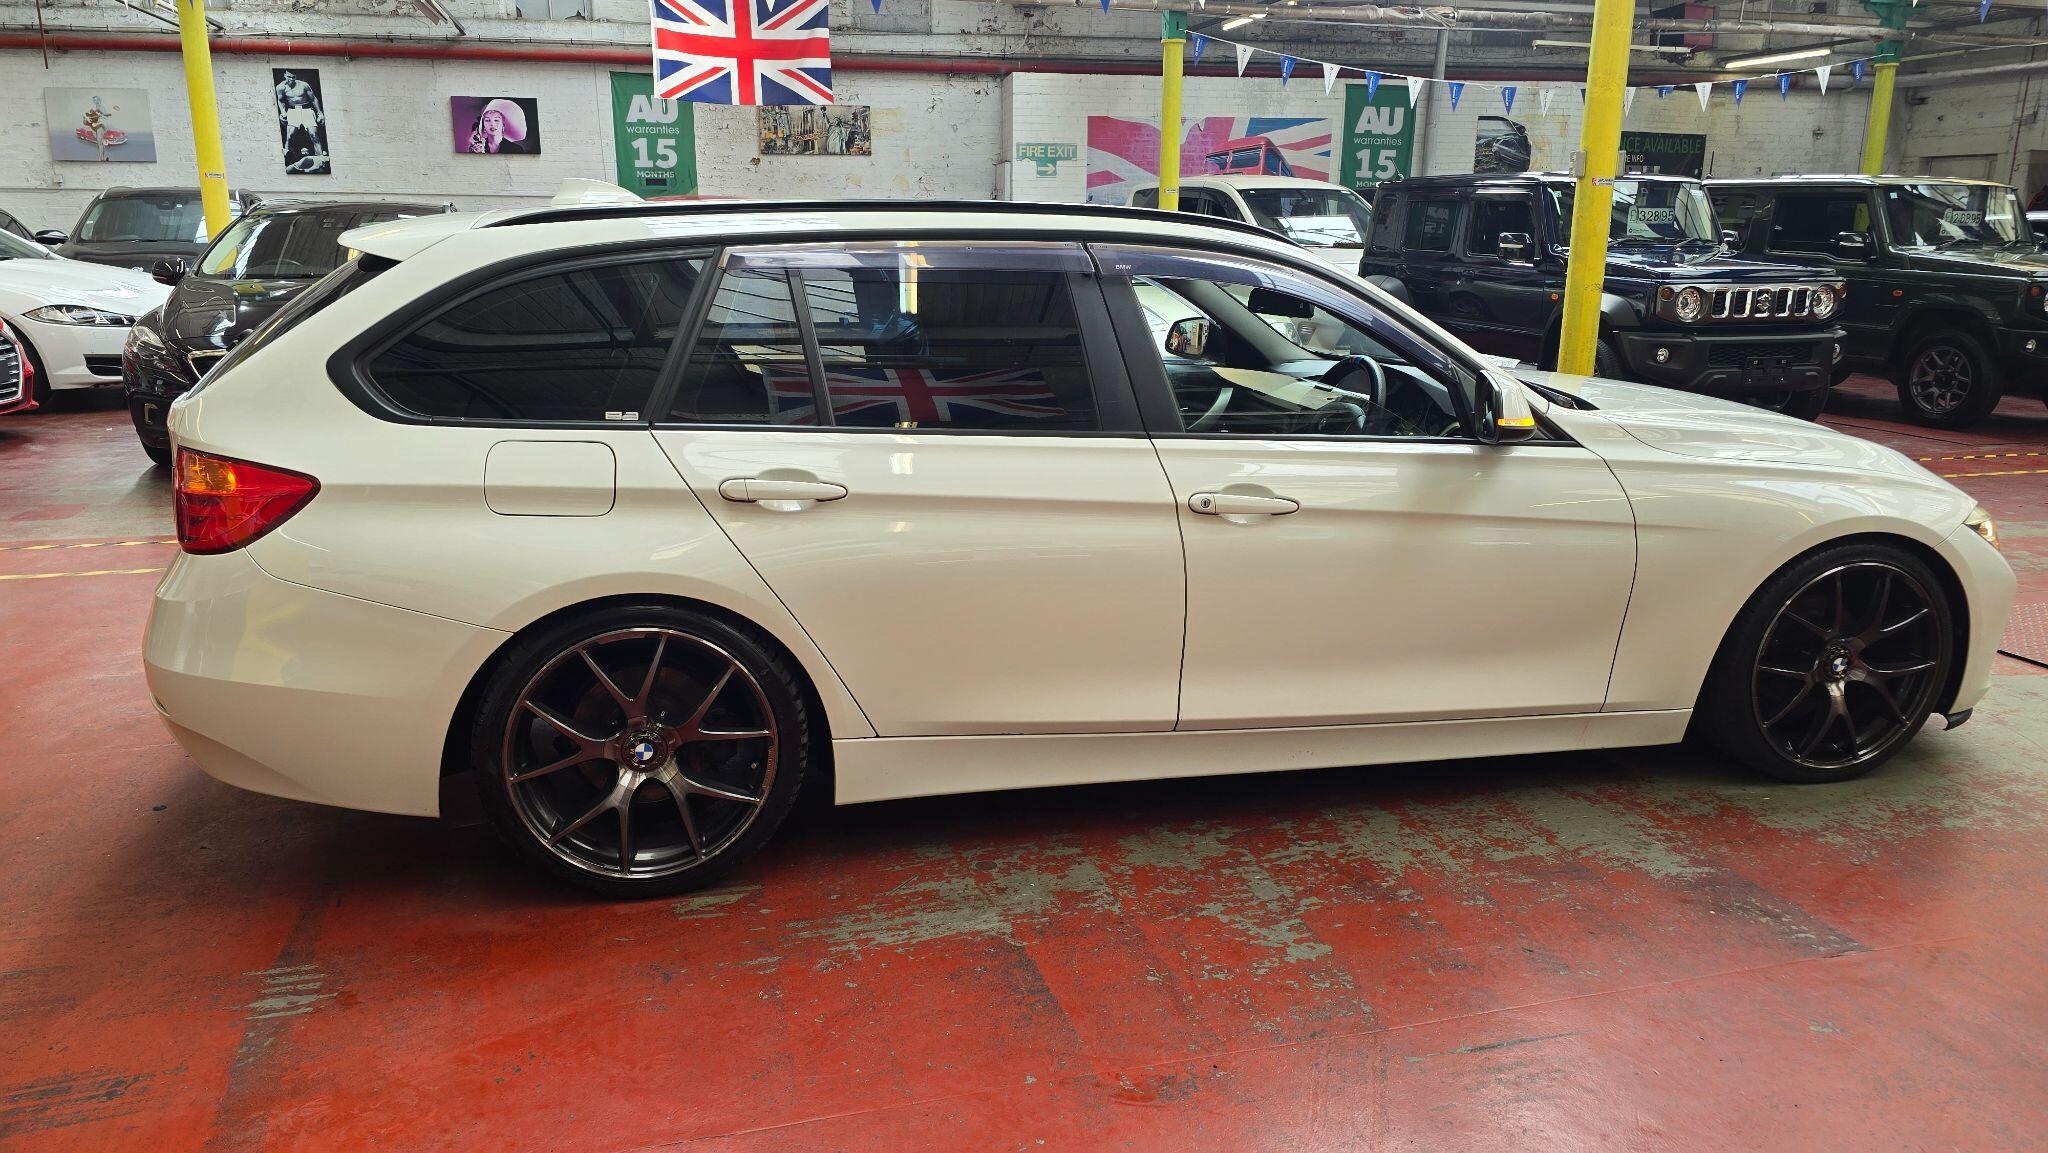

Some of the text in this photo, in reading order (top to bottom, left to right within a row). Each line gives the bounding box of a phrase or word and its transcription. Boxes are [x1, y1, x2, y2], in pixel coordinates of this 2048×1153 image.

[626, 95, 679, 123] AU
[1354, 106, 1405, 135] AU
[627, 125, 680, 134] warranties
[1354, 136, 1402, 146] warranties
[1620, 137, 1701, 154] NCE AVAILABLE
[631, 138, 678, 169] 15
[1019, 145, 1076, 158] FIRE EXIT
[1631, 154, 1644, 163] INFO
[1355, 149, 1397, 179] 15
[636, 170, 675, 178] MONTHS
